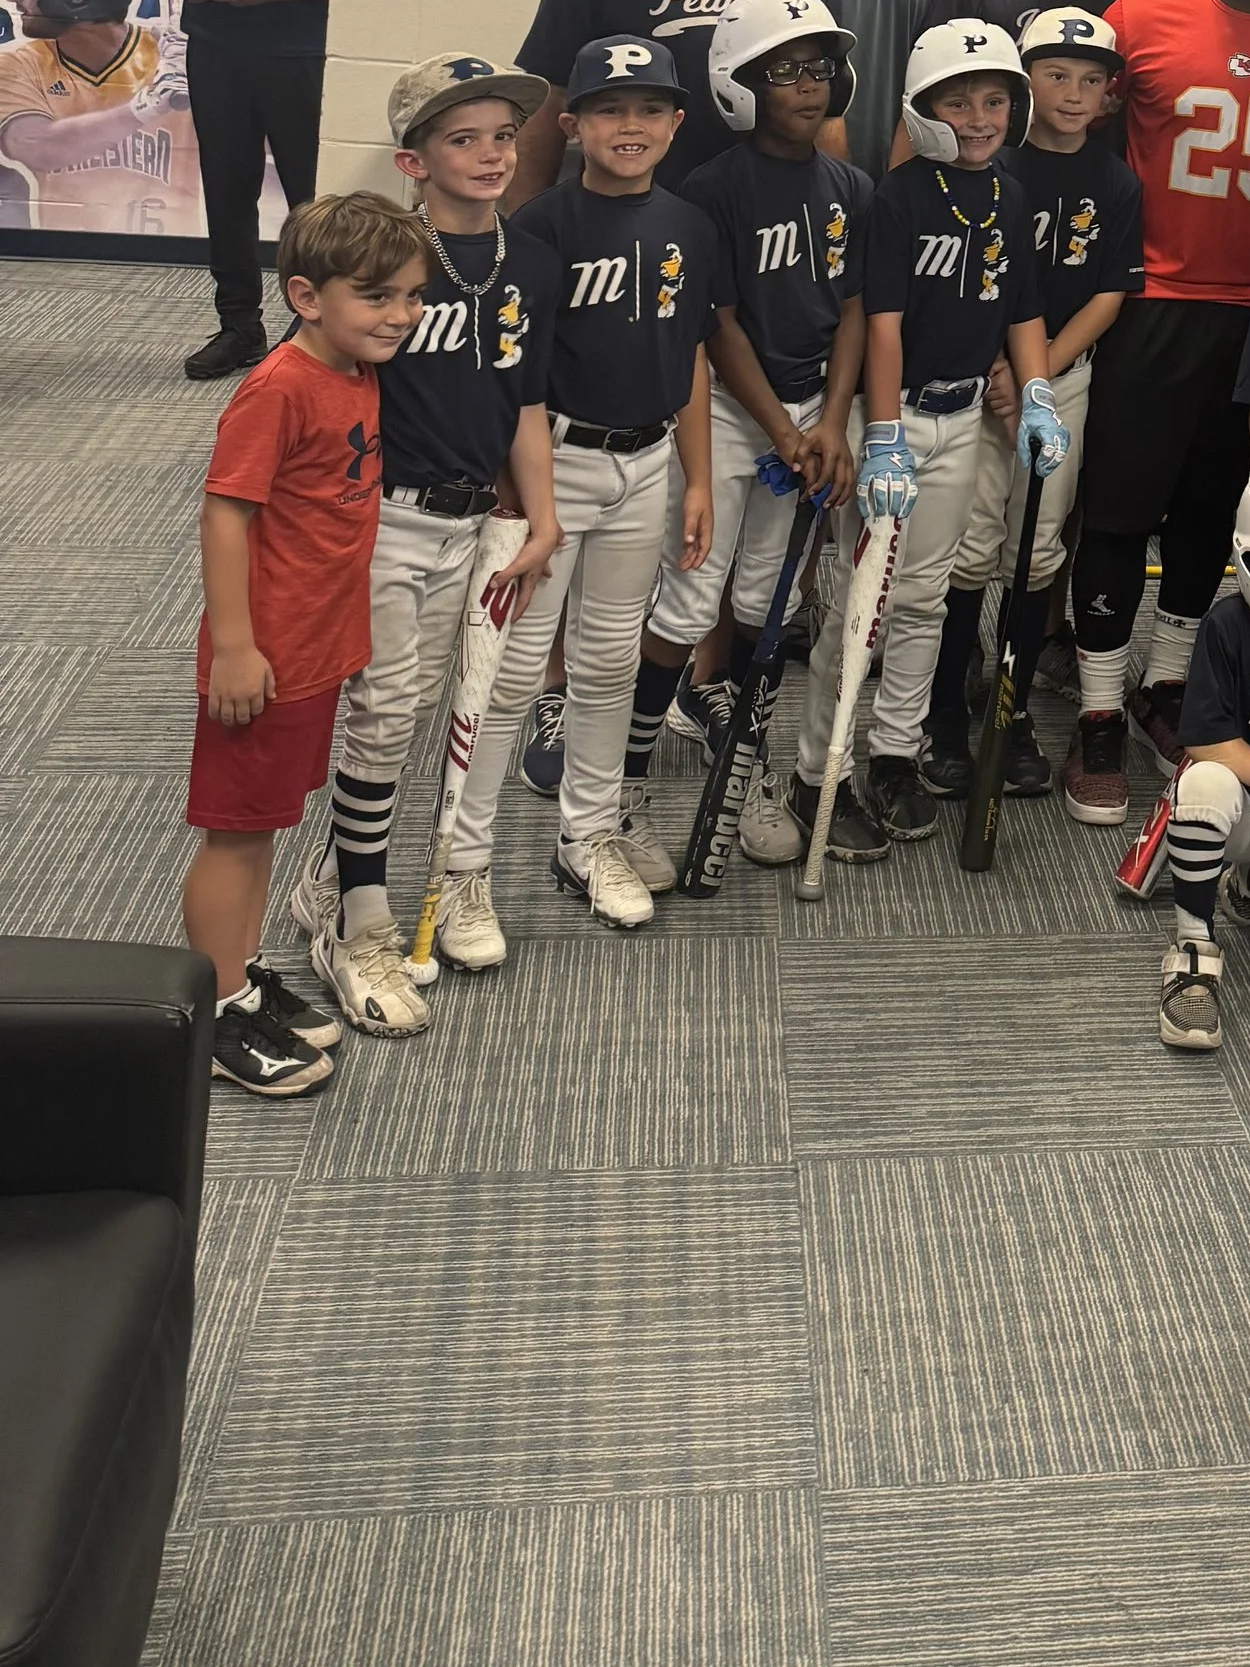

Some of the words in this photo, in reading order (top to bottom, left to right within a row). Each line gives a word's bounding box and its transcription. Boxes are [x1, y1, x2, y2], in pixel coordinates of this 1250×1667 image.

[782, 0, 810, 20] P
[962, 34, 988, 54] P
[1058, 18, 1096, 45] P
[441, 57, 495, 81] P
[603, 44, 652, 80] P
[467, 713, 480, 764] marucci
[701, 742, 757, 887] marucci
